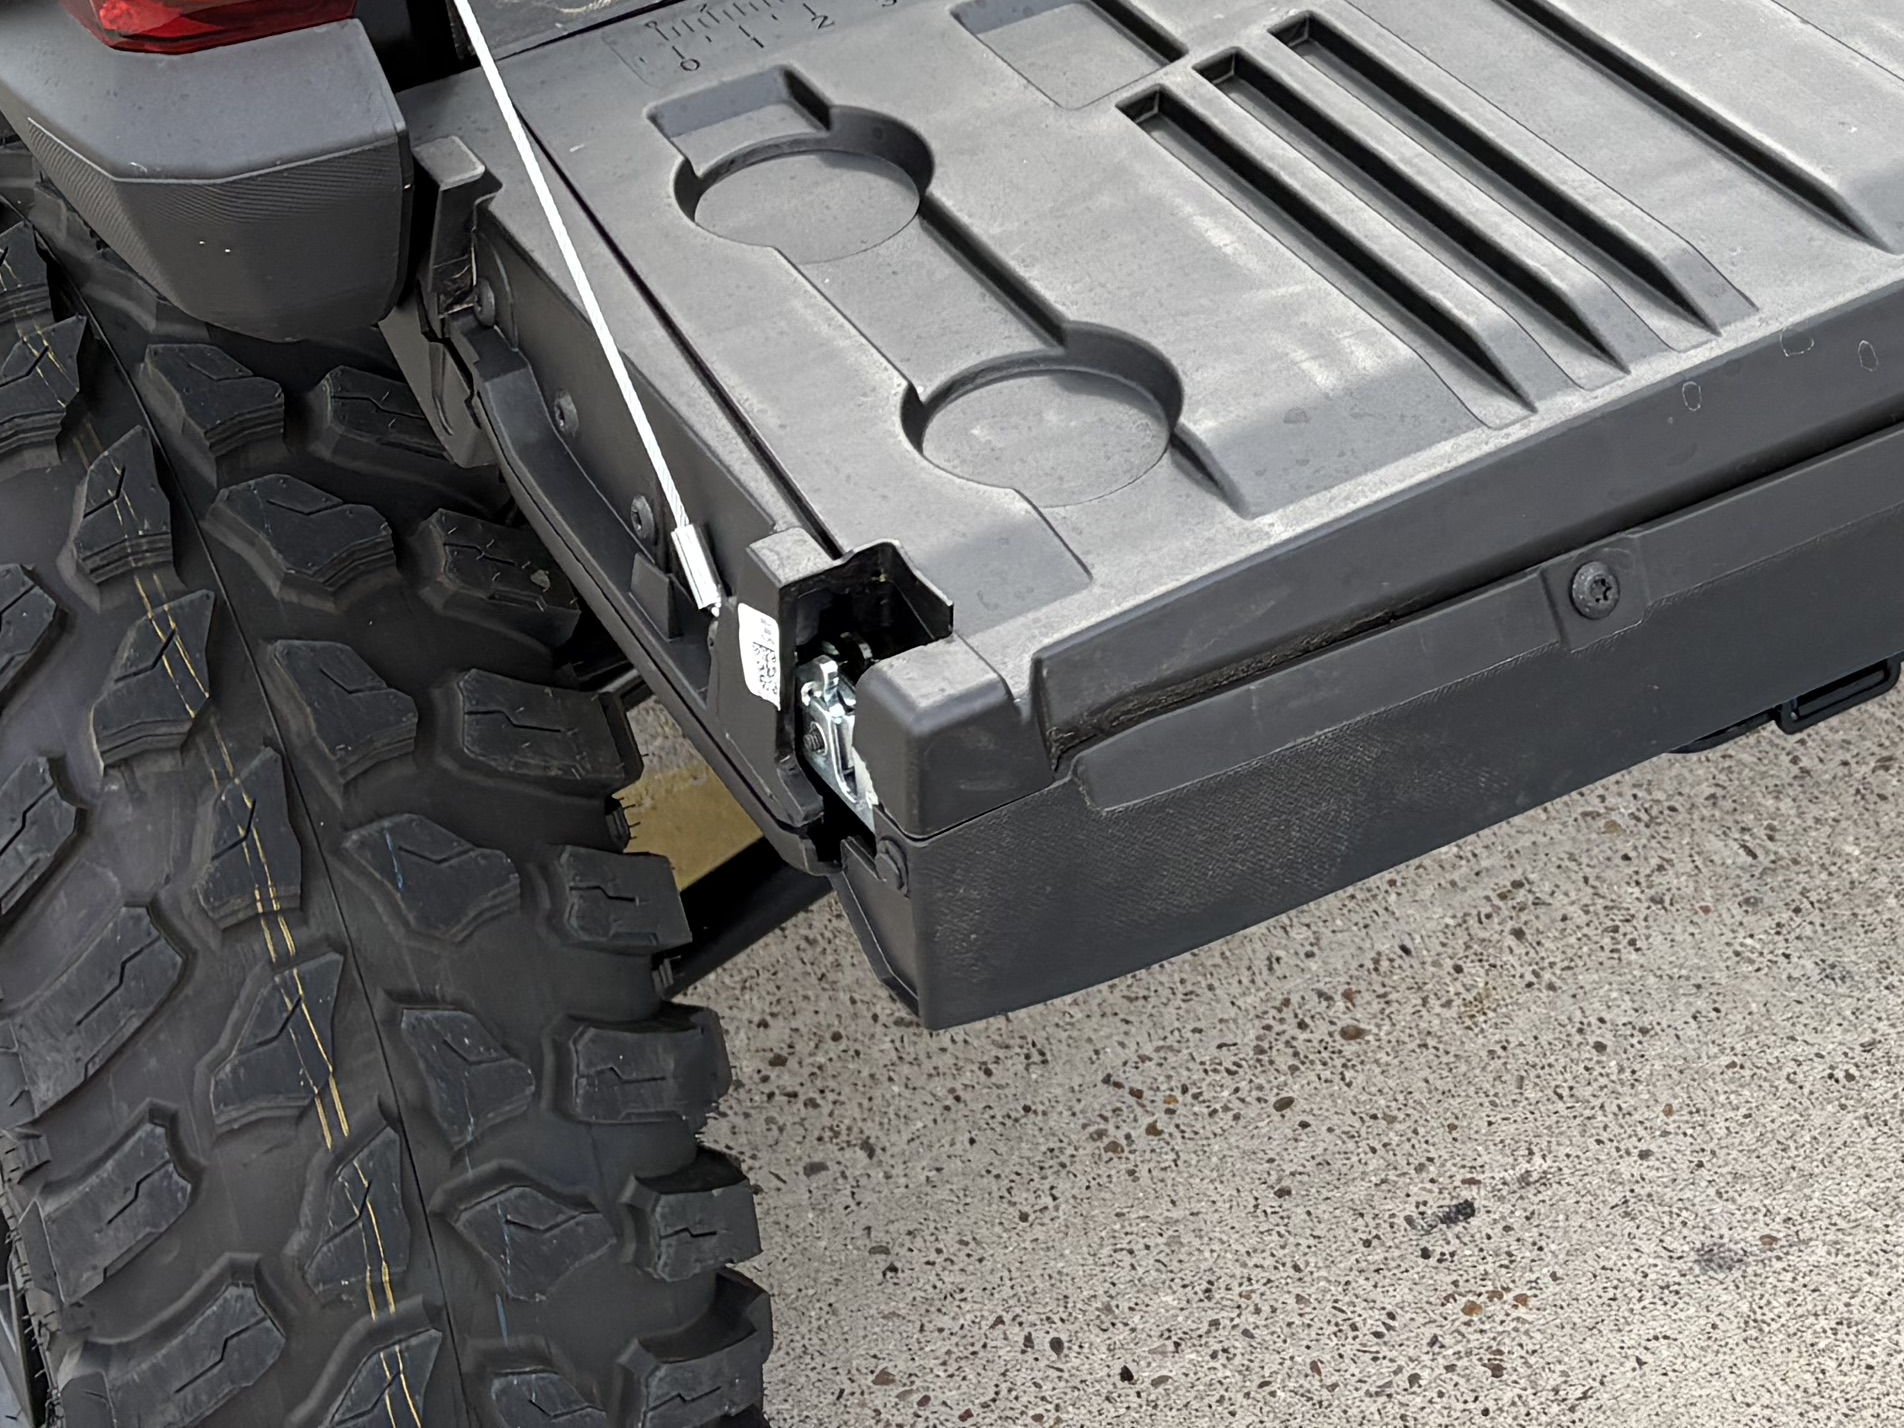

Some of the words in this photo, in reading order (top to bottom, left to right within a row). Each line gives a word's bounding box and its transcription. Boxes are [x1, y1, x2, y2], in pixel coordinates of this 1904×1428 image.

[679, 58, 700, 71] 0
[752, 38, 764, 47] 1
[812, 15, 834, 29] 2
